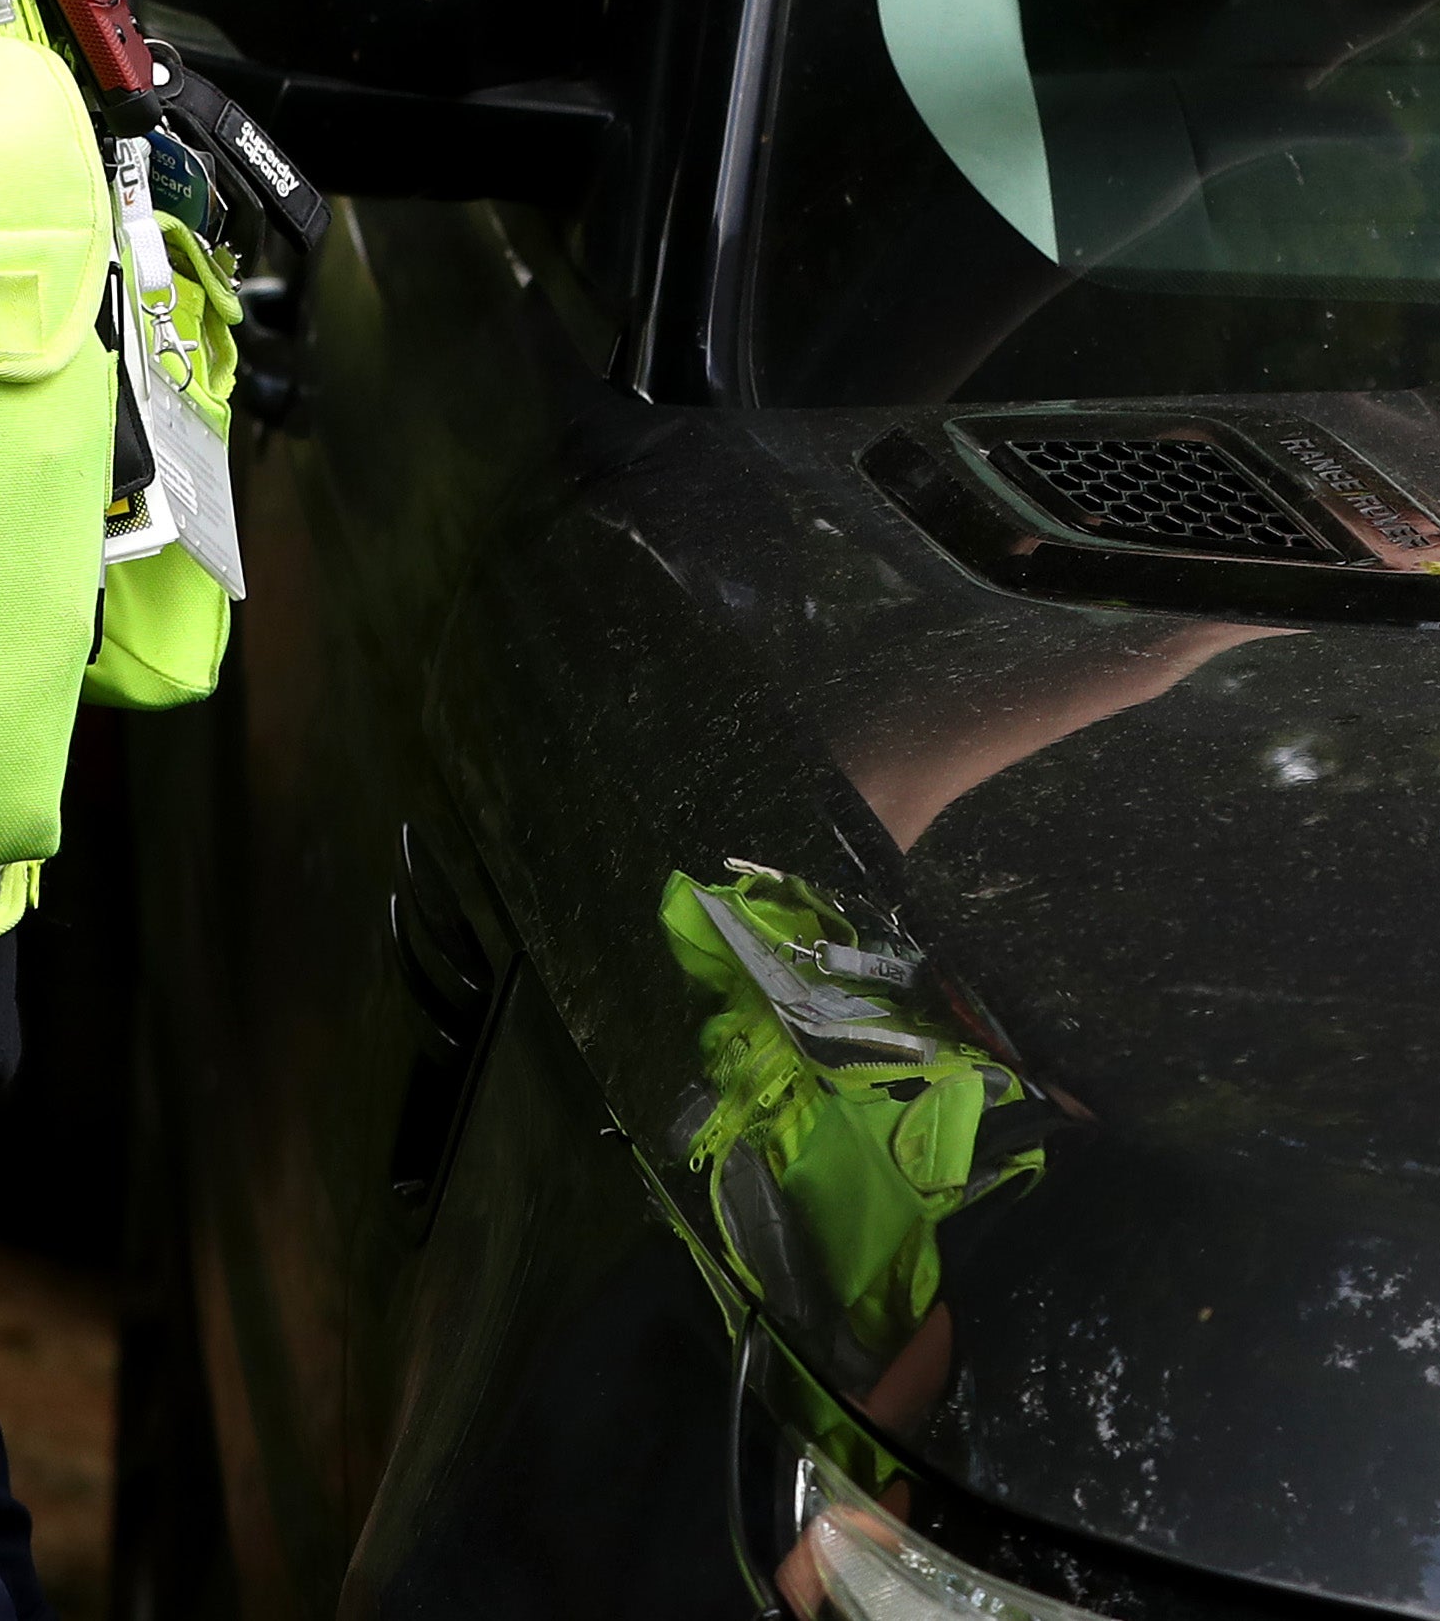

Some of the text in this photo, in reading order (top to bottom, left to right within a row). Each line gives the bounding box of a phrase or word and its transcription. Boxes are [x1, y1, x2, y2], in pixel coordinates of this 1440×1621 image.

[152, 165, 193, 200] bcard
[235, 135, 280, 186] Japan
[240, 121, 300, 191] Superdry
[1280, 439, 1367, 492] RANGE
[1347, 494, 1431, 549] ROVER
